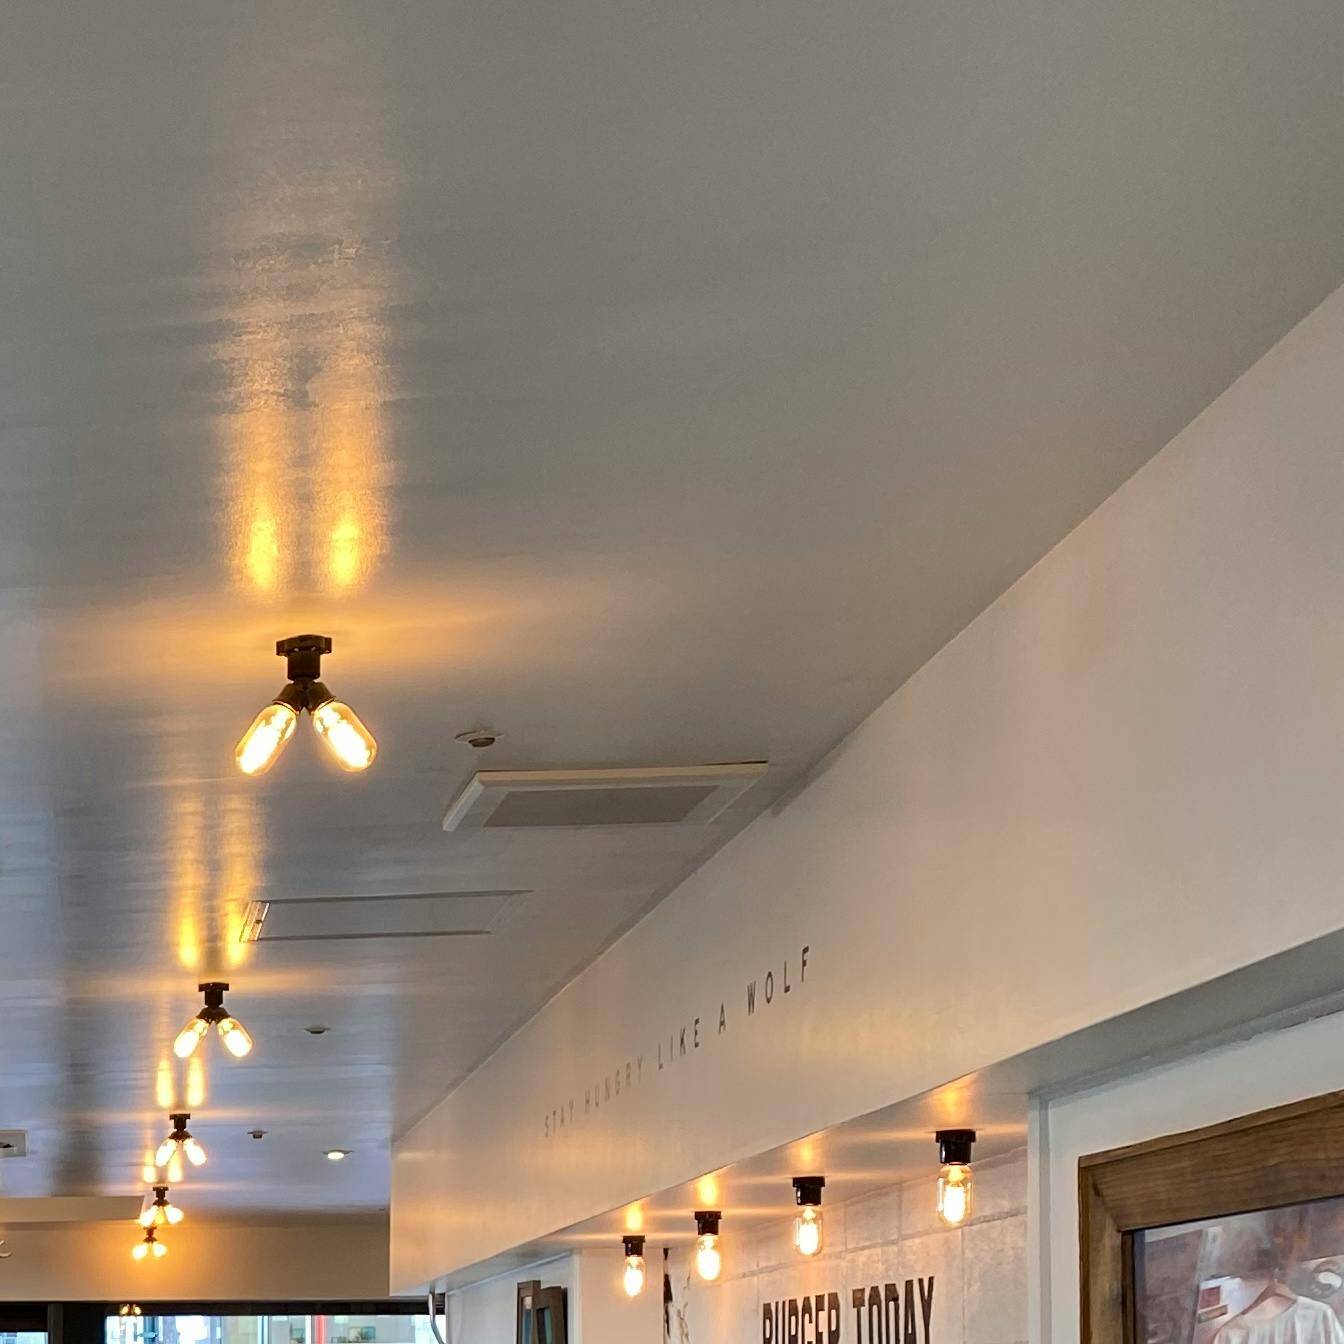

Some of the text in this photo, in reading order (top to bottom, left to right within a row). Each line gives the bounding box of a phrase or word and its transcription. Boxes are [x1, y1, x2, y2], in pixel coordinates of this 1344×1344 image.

[545, 945, 810, 1137] STAY HUNGRY LIKE A WOLF
